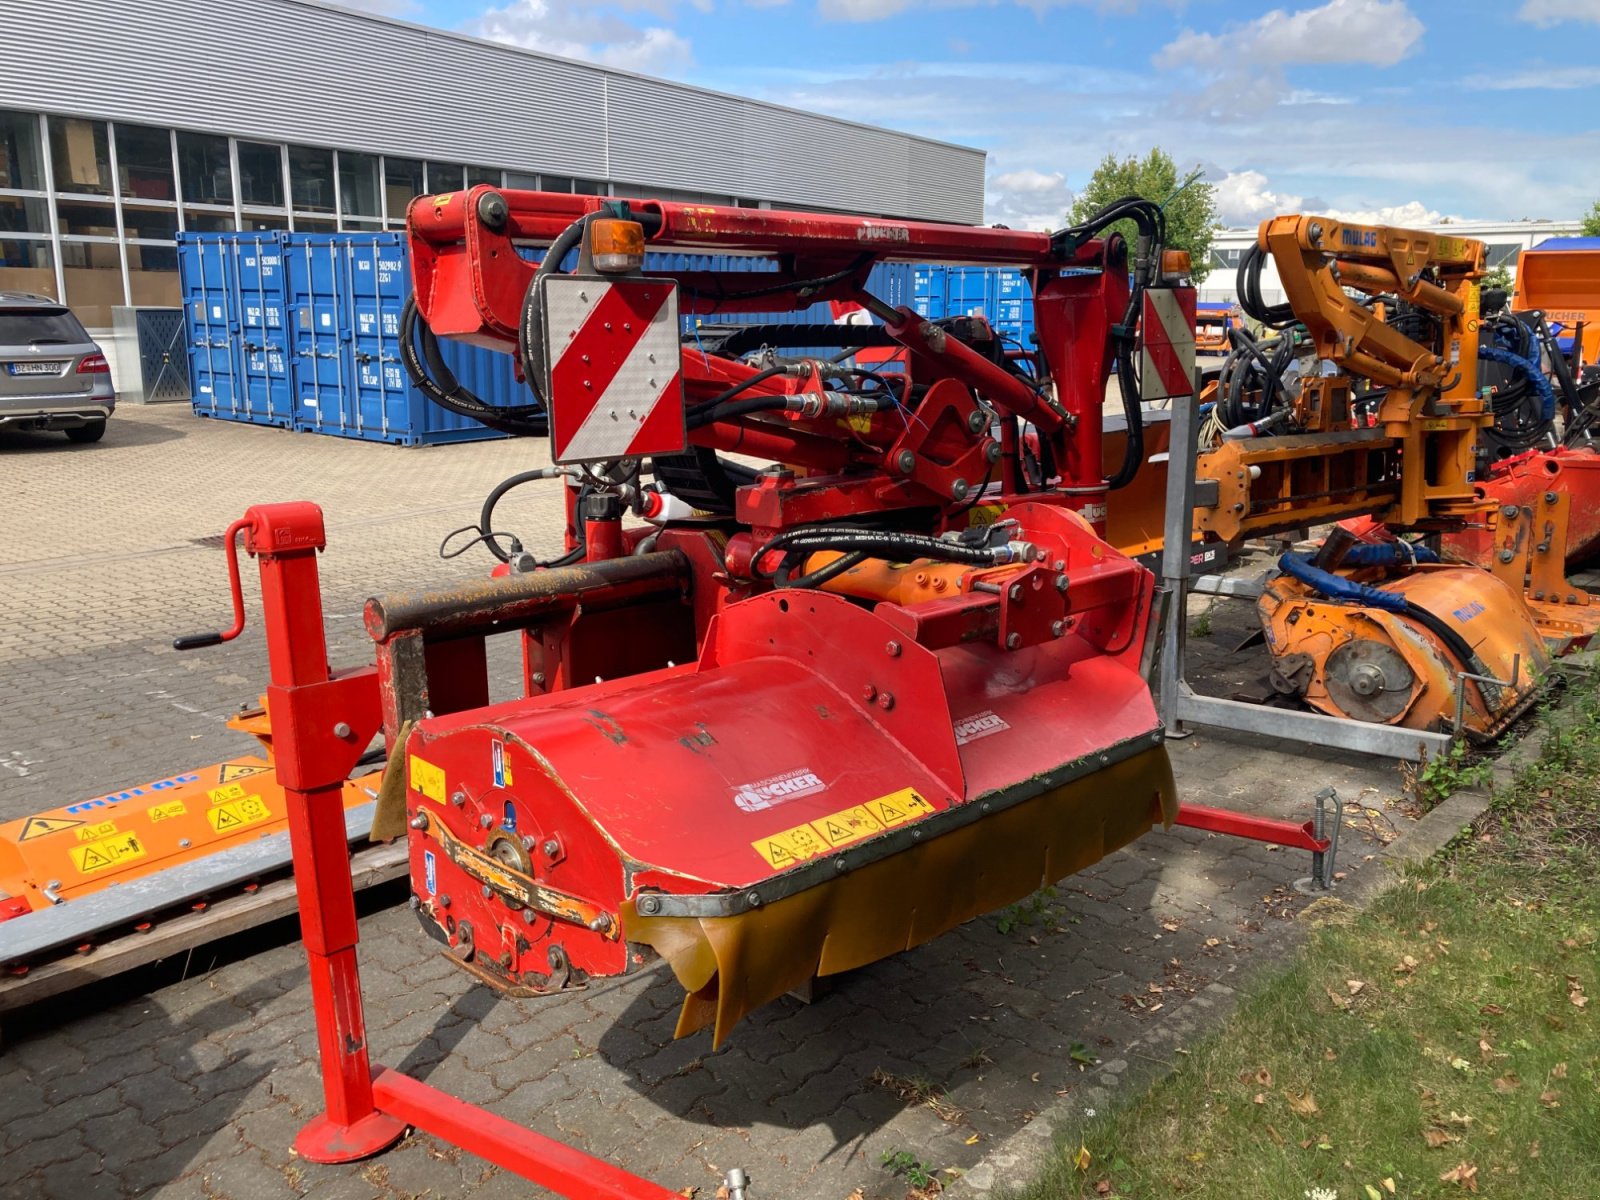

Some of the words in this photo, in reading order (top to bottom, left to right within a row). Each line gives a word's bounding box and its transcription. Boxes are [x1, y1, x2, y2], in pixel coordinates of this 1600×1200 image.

[1342, 228, 1377, 247] MULAG
[1545, 311, 1585, 321] UCHER
[66, 773, 200, 815] MULAG
